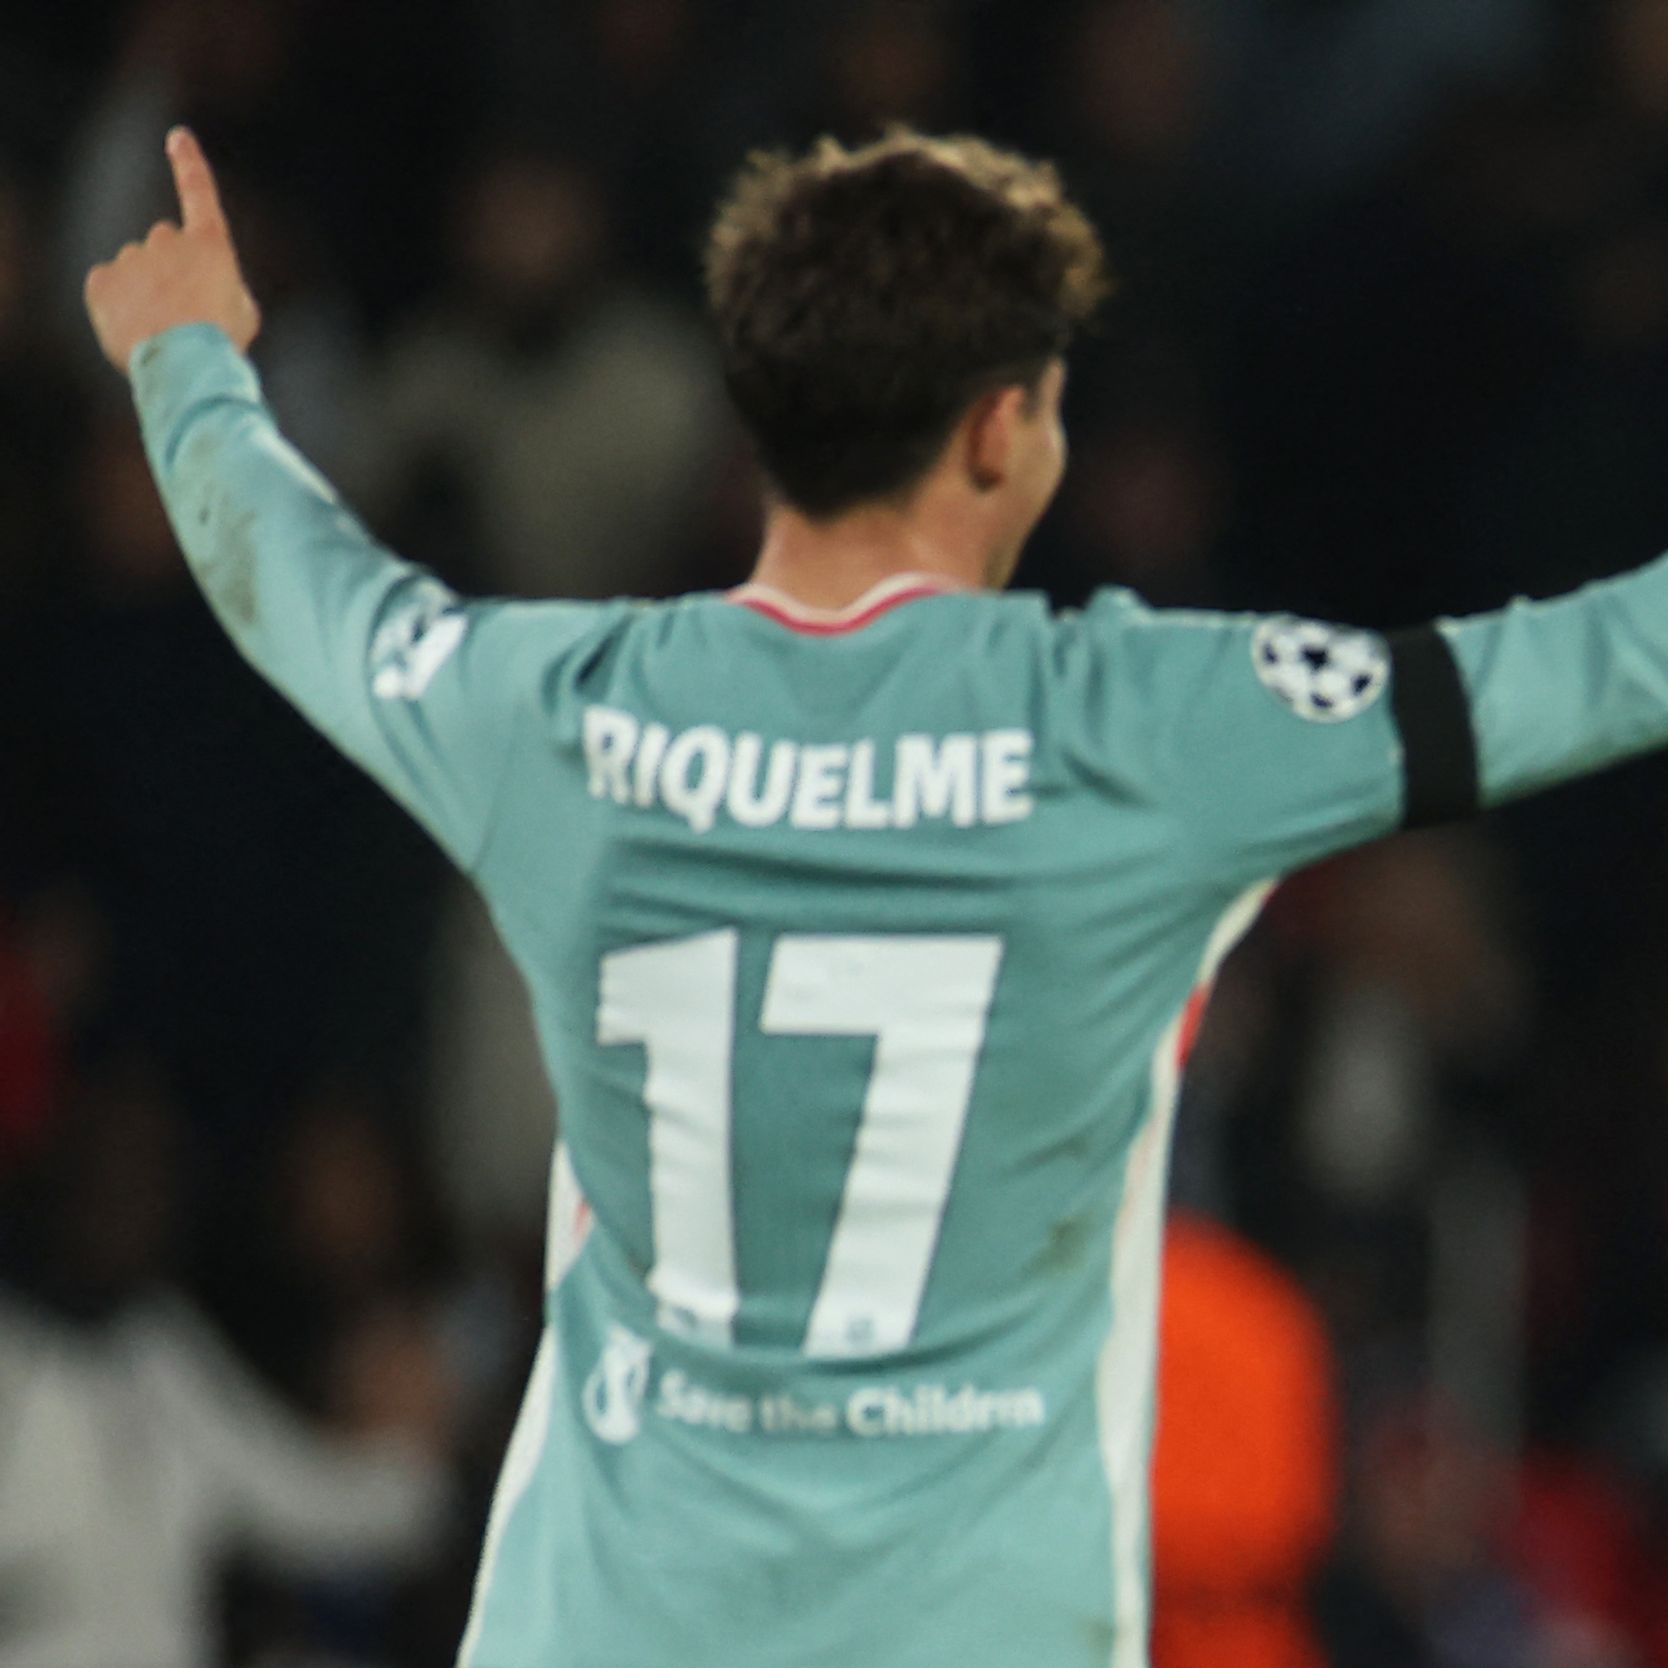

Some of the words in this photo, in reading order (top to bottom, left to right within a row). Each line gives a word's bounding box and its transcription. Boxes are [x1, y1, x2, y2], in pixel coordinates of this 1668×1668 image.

[585, 706, 1034, 830] RIQUELME
[596, 927, 1005, 1358] 17
[658, 1368, 752, 1432] Save
[760, 1394, 838, 1432] the
